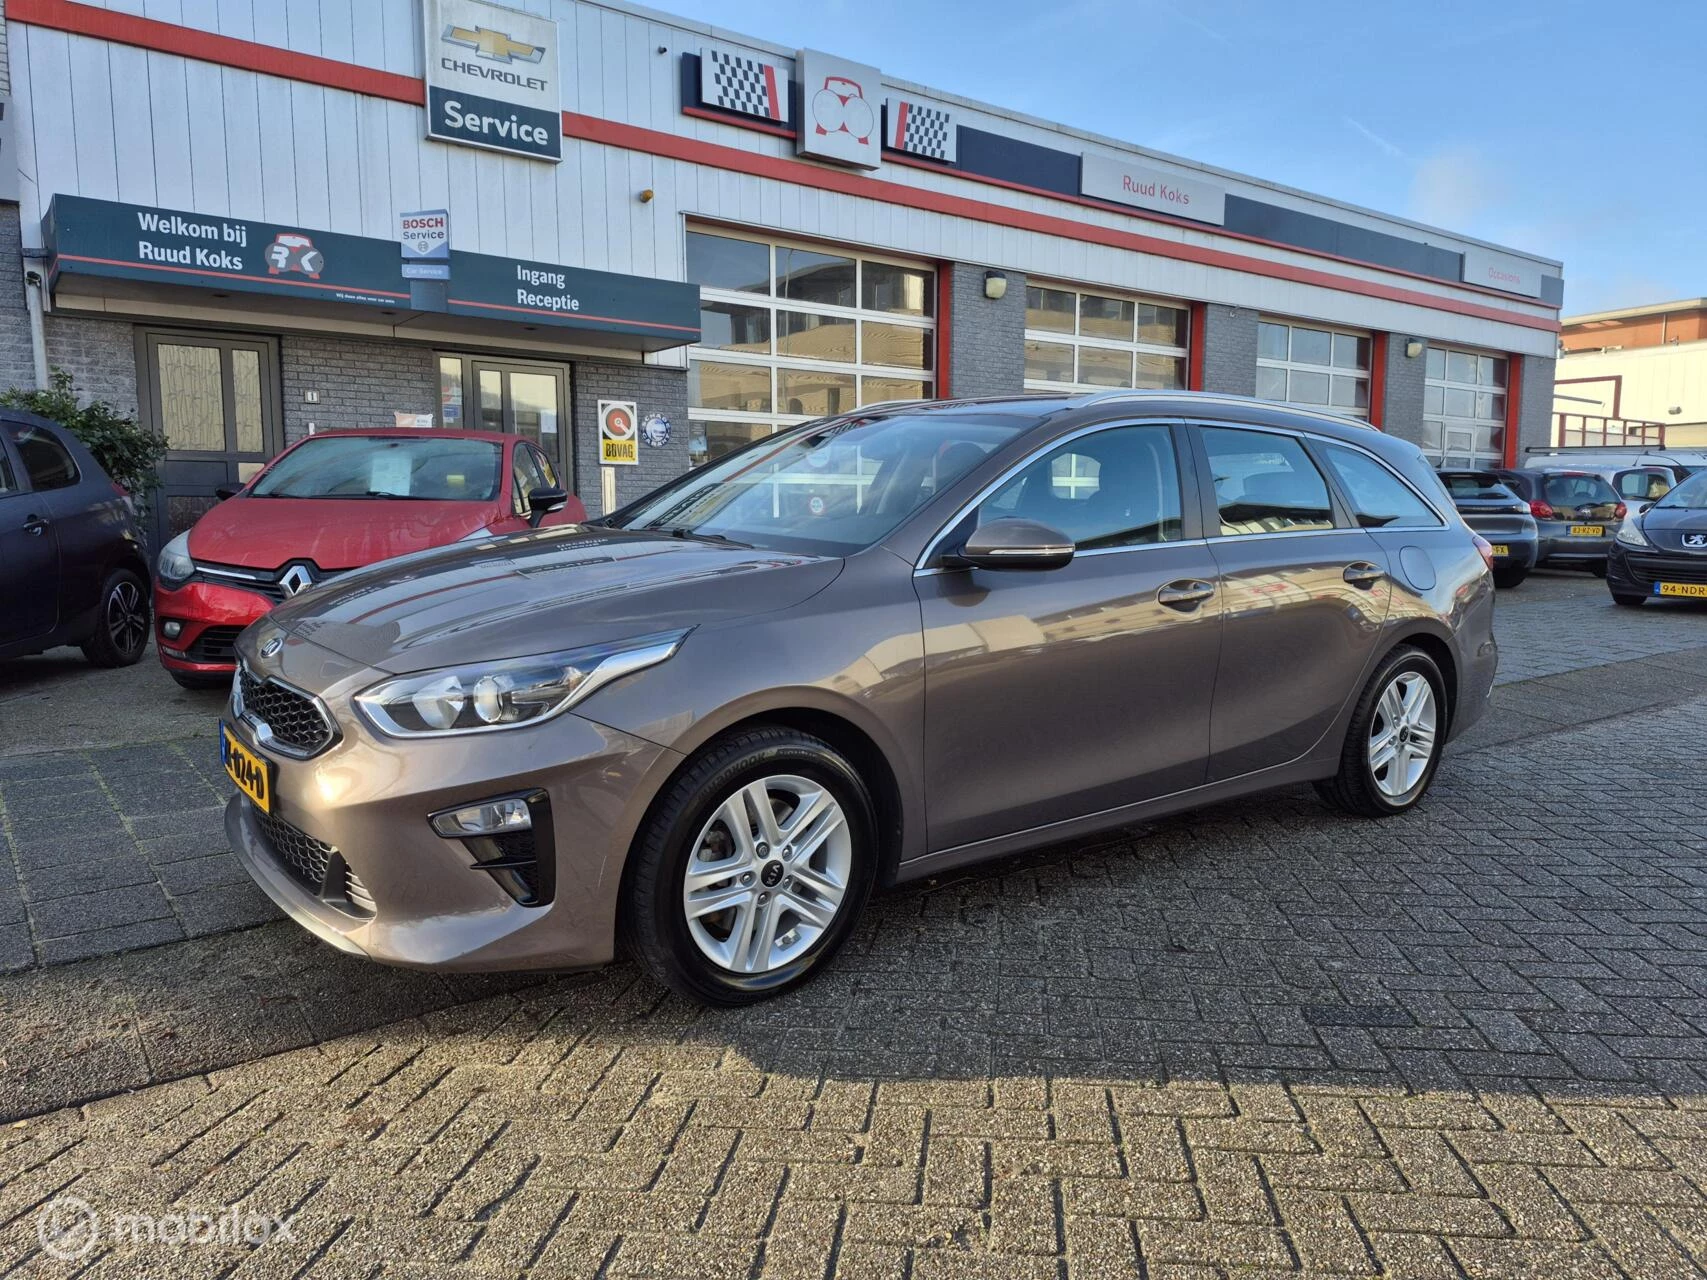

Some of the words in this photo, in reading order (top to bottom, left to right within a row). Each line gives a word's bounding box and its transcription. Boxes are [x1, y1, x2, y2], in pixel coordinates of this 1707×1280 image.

[441, 57, 548, 92] CHEVROLET
[444, 100, 549, 145] Service
[1123, 175, 1156, 197] Ruud
[1160, 184, 1190, 205] Koks
[137, 212, 219, 240] Welkom
[223, 222, 248, 248] bij
[402, 217, 444, 229] BOSCH
[403, 230, 445, 240] Service
[138, 241, 191, 265] Ruud
[195, 247, 243, 270] Koks
[517, 264, 566, 289] Ingang
[517, 288, 580, 311] Receptie
[605, 443, 634, 458] BOVAG
[766, 863, 781, 886] KIA
